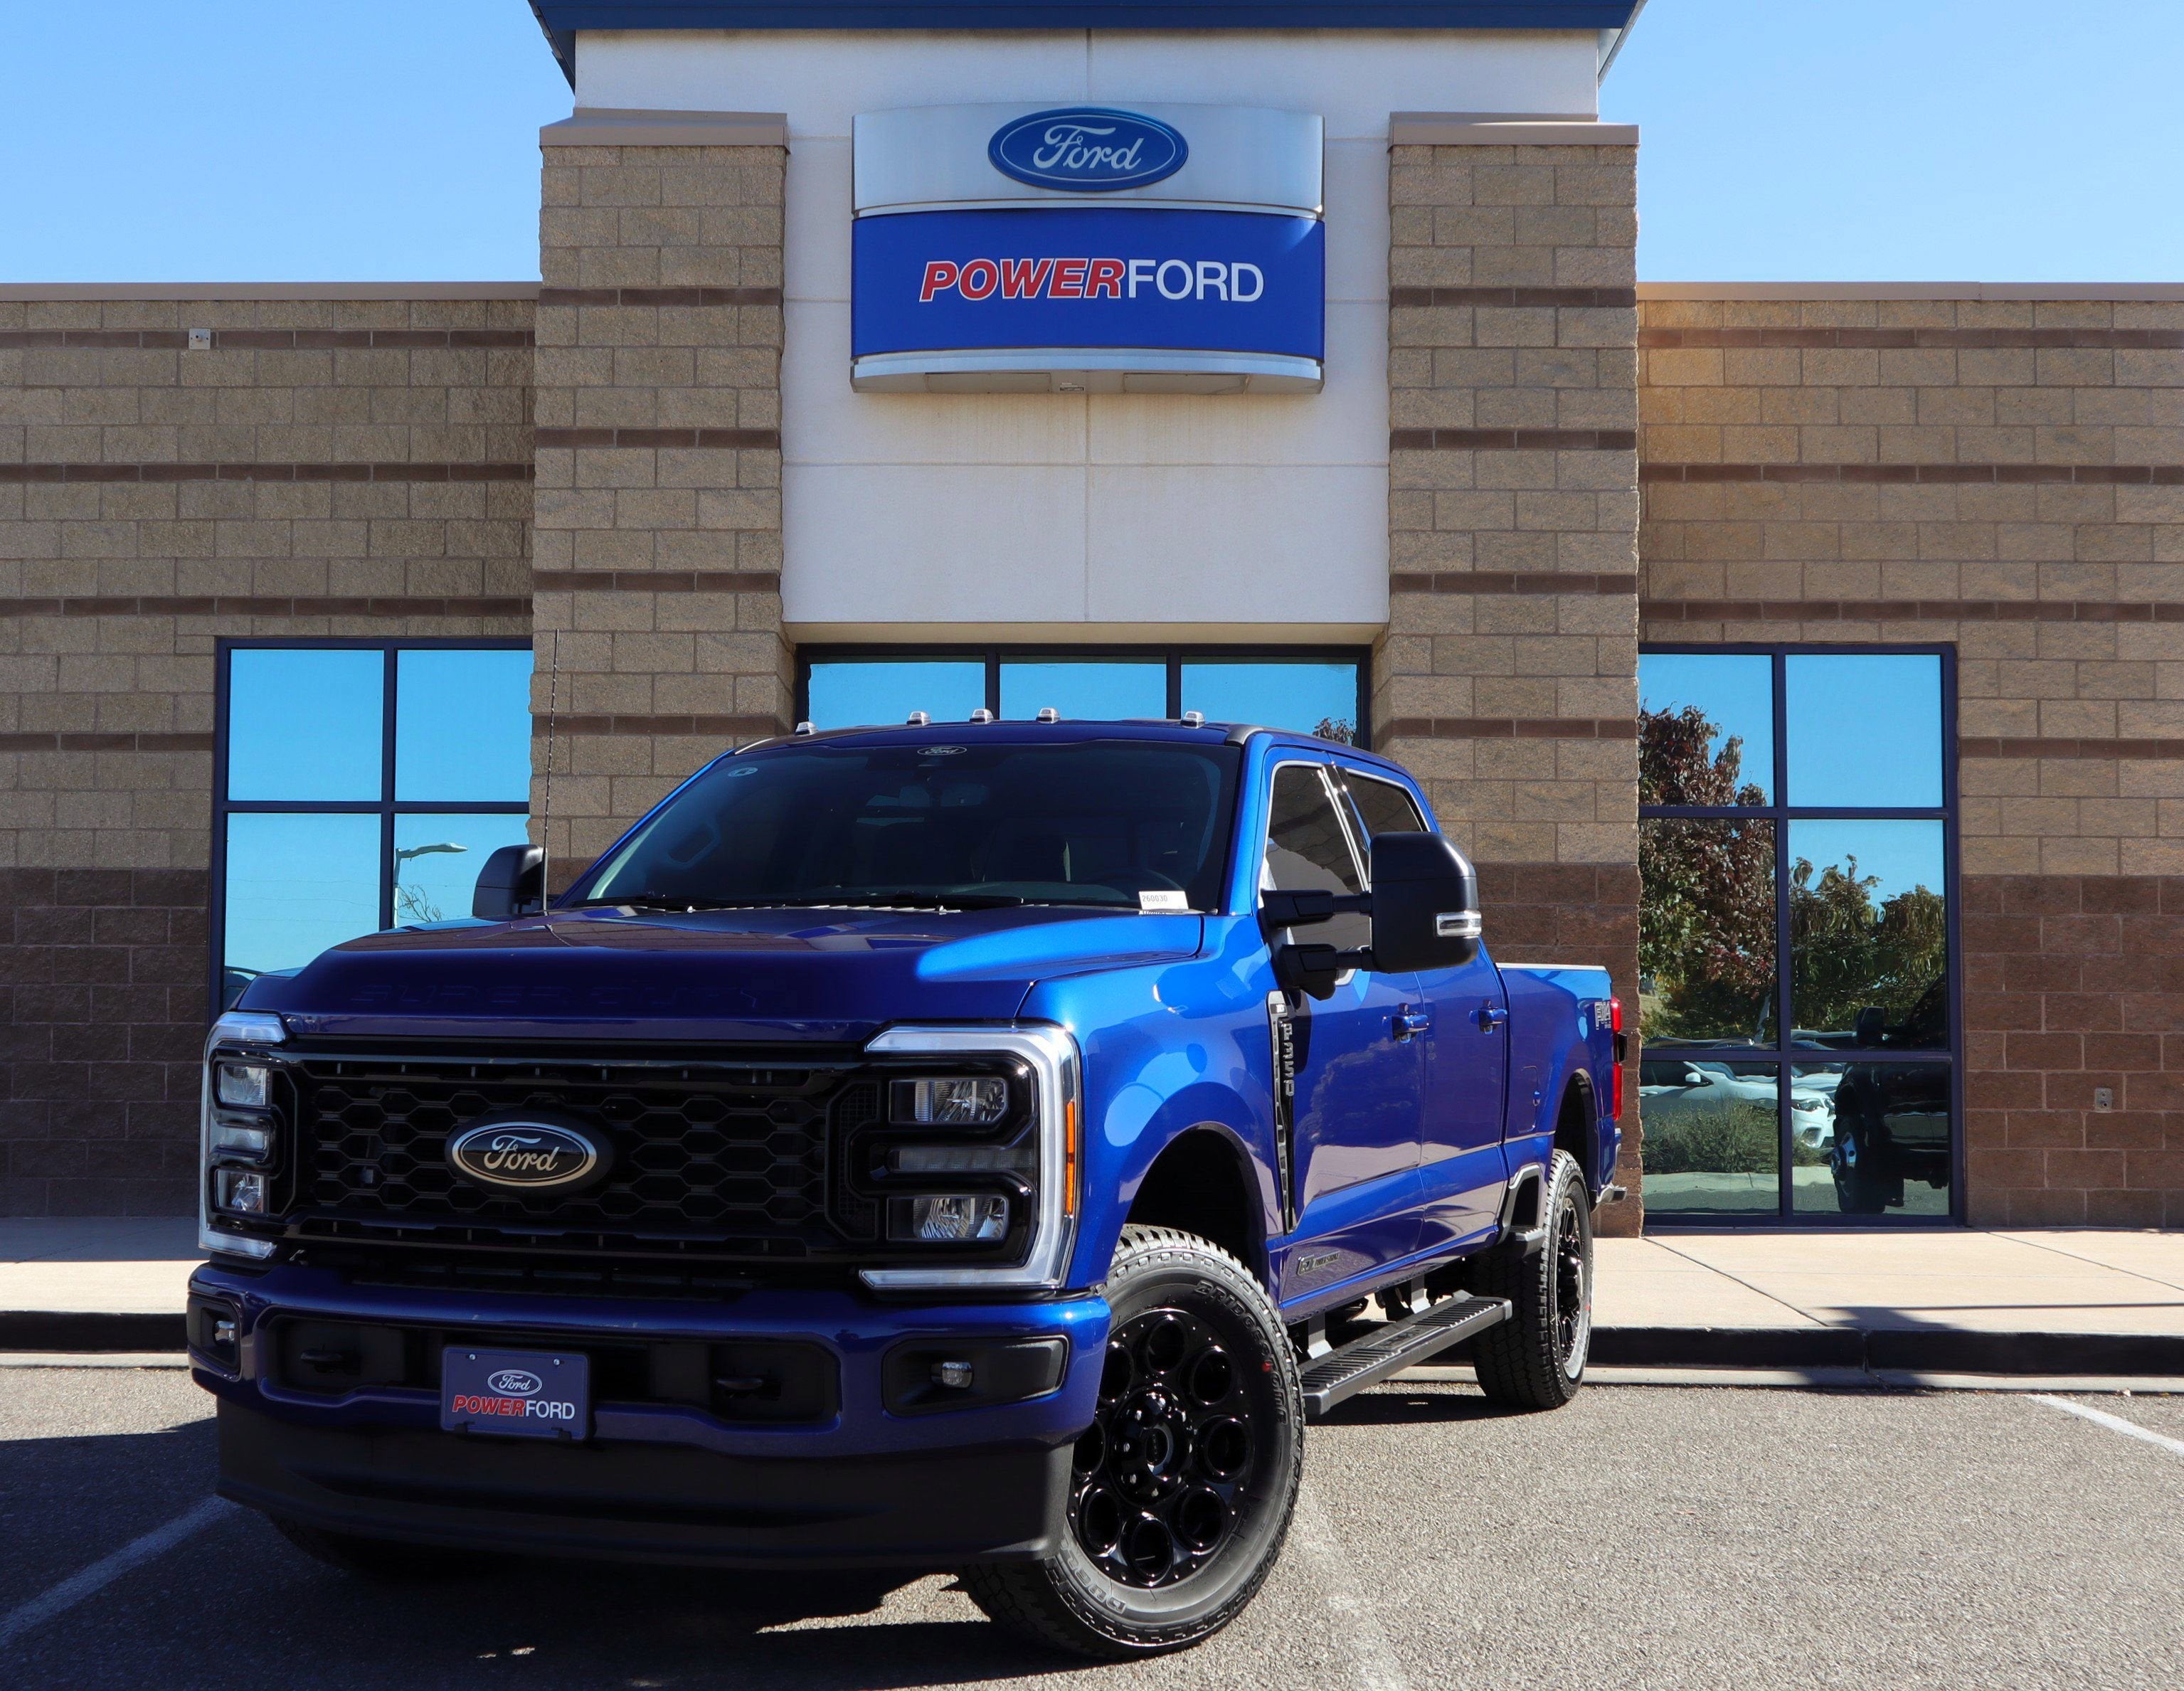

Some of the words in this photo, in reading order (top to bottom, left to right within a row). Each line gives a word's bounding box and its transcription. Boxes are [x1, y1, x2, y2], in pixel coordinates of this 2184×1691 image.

[1033, 124, 1144, 170] Ford
[919, 258, 1264, 302] POWERFORD
[484, 1135, 561, 1172] Ford
[498, 1374, 531, 1392] Ford
[452, 1394, 576, 1420] POWERFORD
